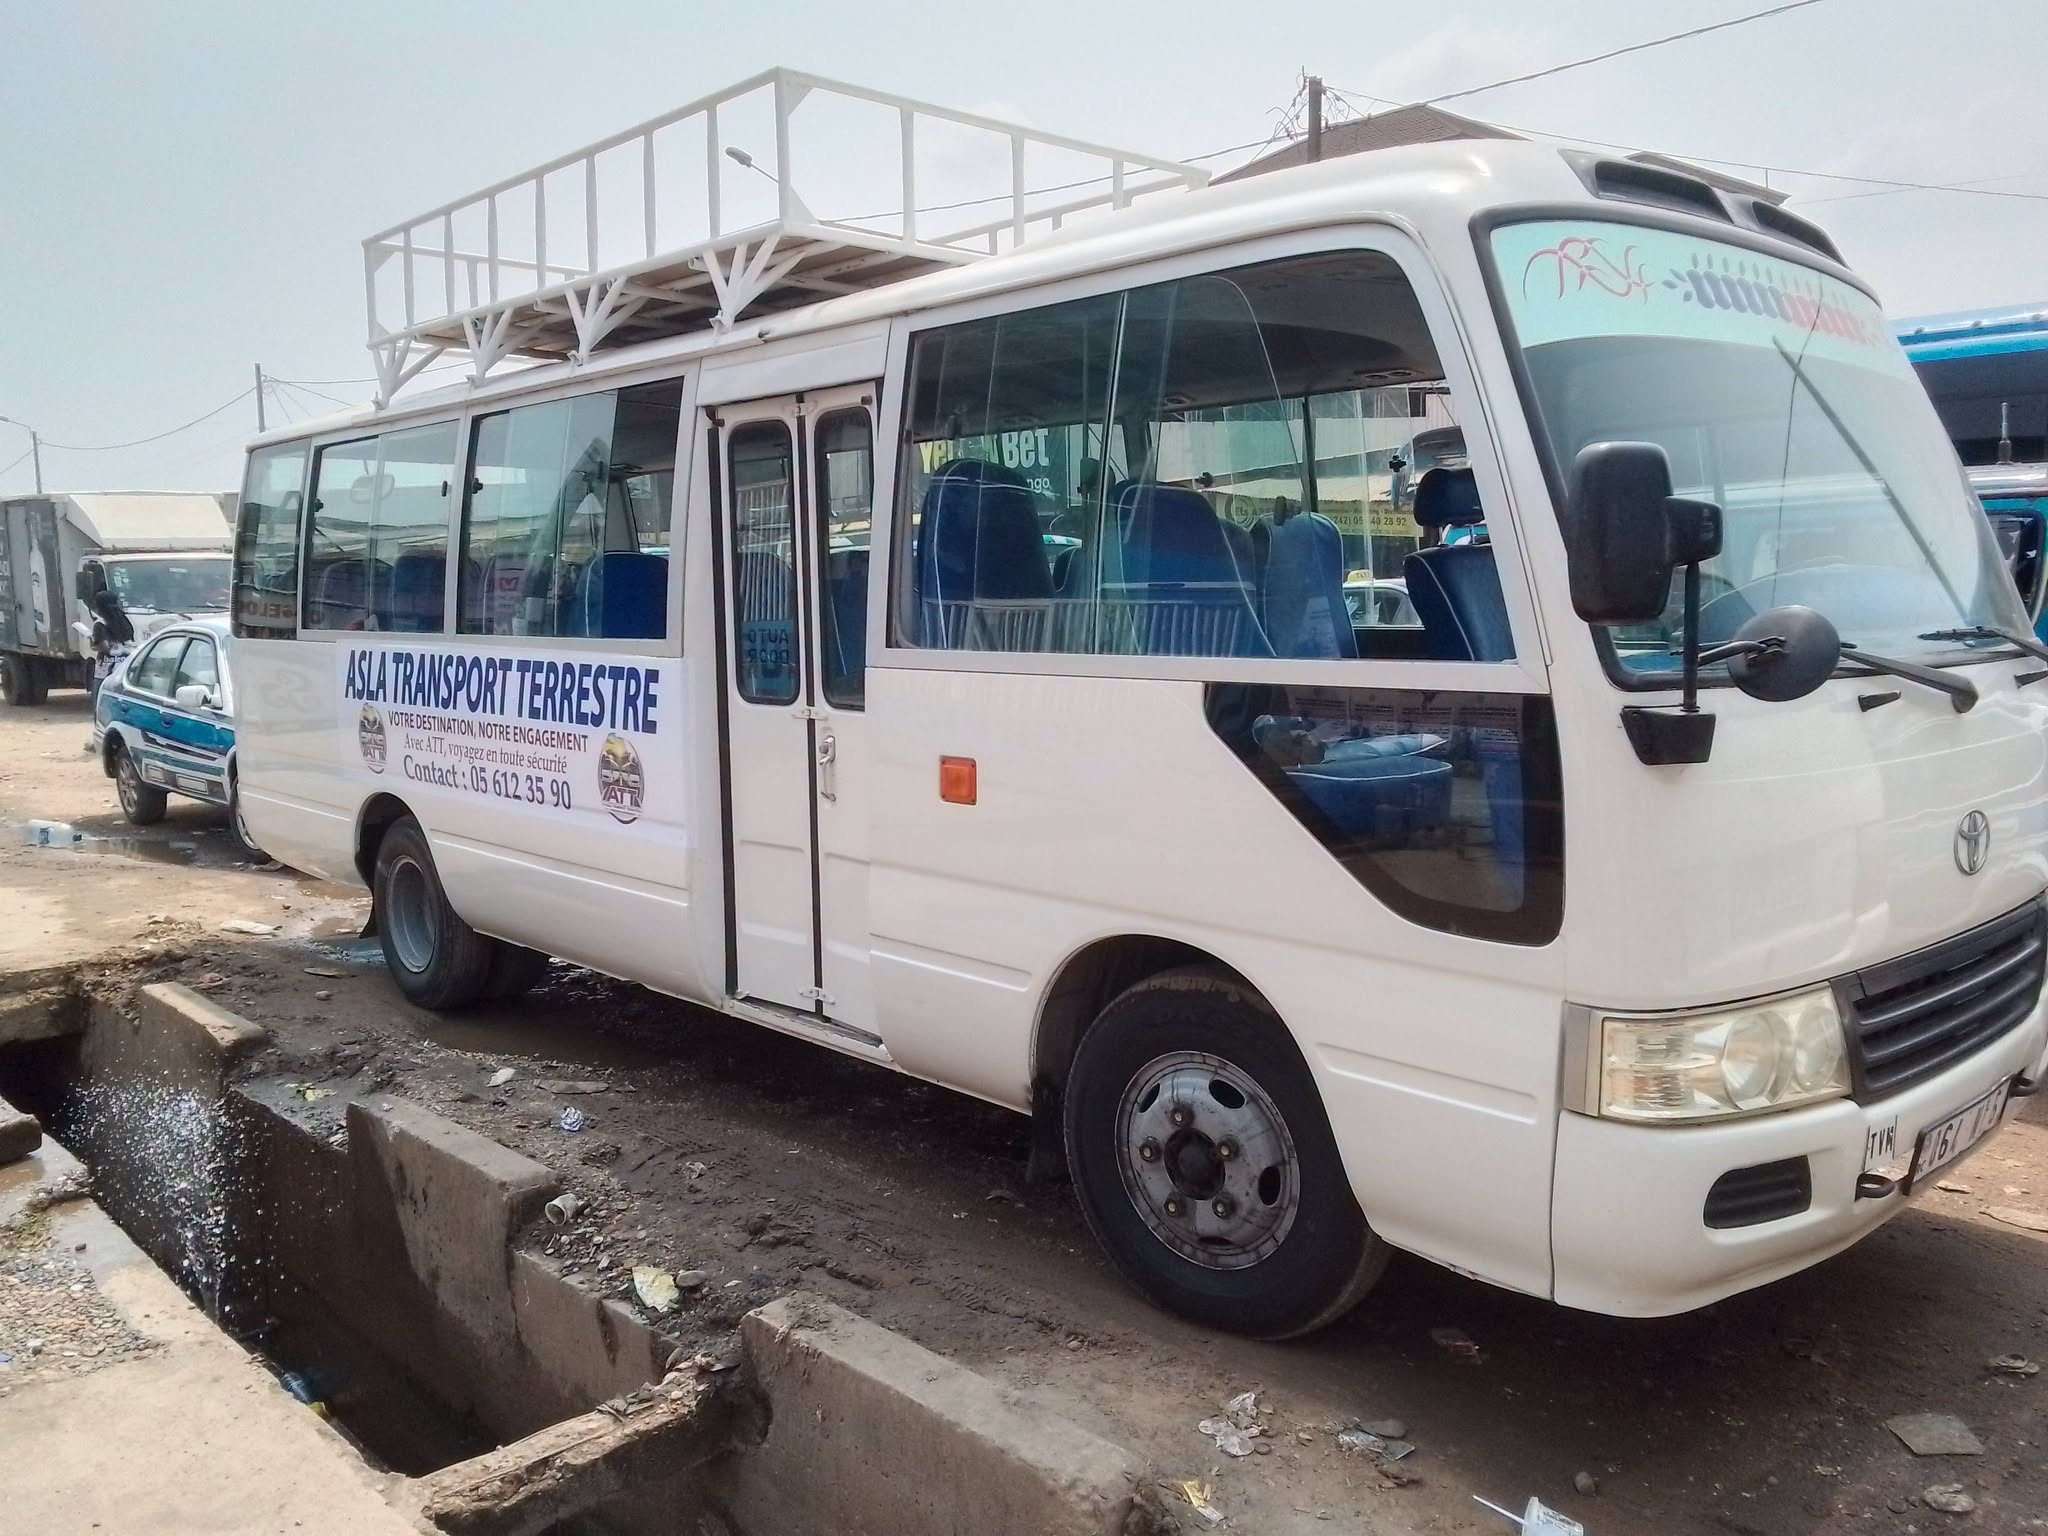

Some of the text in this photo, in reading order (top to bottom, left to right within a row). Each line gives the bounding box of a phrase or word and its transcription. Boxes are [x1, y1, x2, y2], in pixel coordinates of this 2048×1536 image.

[345, 650, 660, 734] ASLA TRANSPORT TERRESTRE
[388, 711, 589, 753] VOTRE DESTINATION, NOTRE ENGAGEMENT
[404, 732, 568, 774] Avec ATT, voyagez en toute sécurité
[403, 754, 459, 789] Contact
[470, 765, 488, 793] 05
[492, 769, 522, 801] 612
[525, 774, 545, 805] 35
[550, 778, 571, 810] 90
